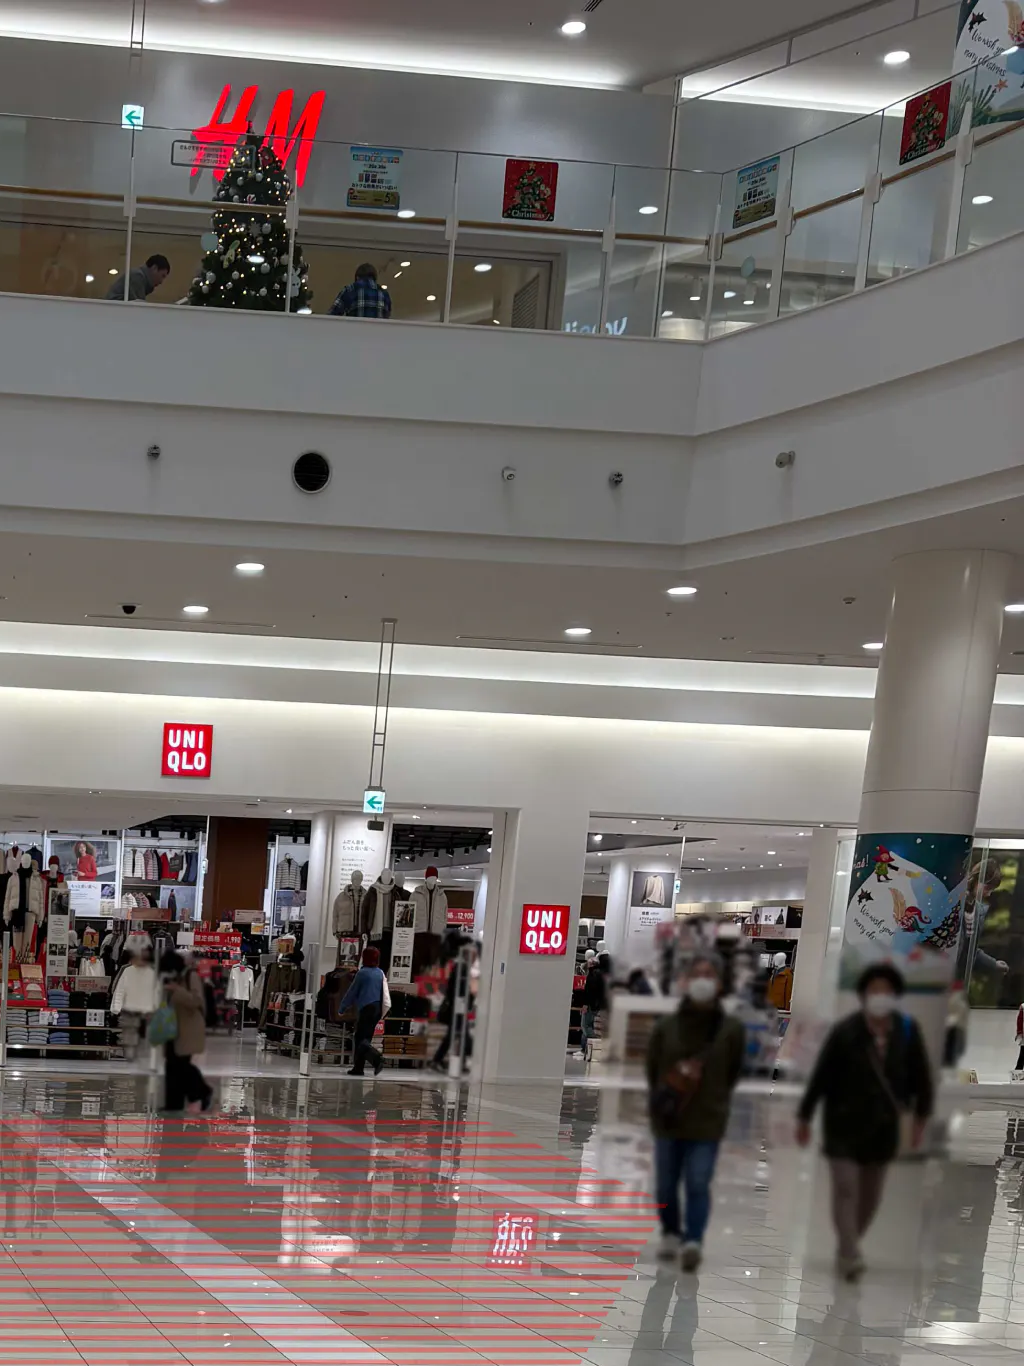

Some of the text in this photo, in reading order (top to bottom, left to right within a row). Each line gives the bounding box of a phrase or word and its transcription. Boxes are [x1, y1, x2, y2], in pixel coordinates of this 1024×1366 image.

[511, 209, 546, 219] Christmas
[168, 729, 204, 749] UNI
[167, 750, 207, 773] QLO
[527, 909, 562, 929] UNI
[525, 930, 563, 951] QLO
